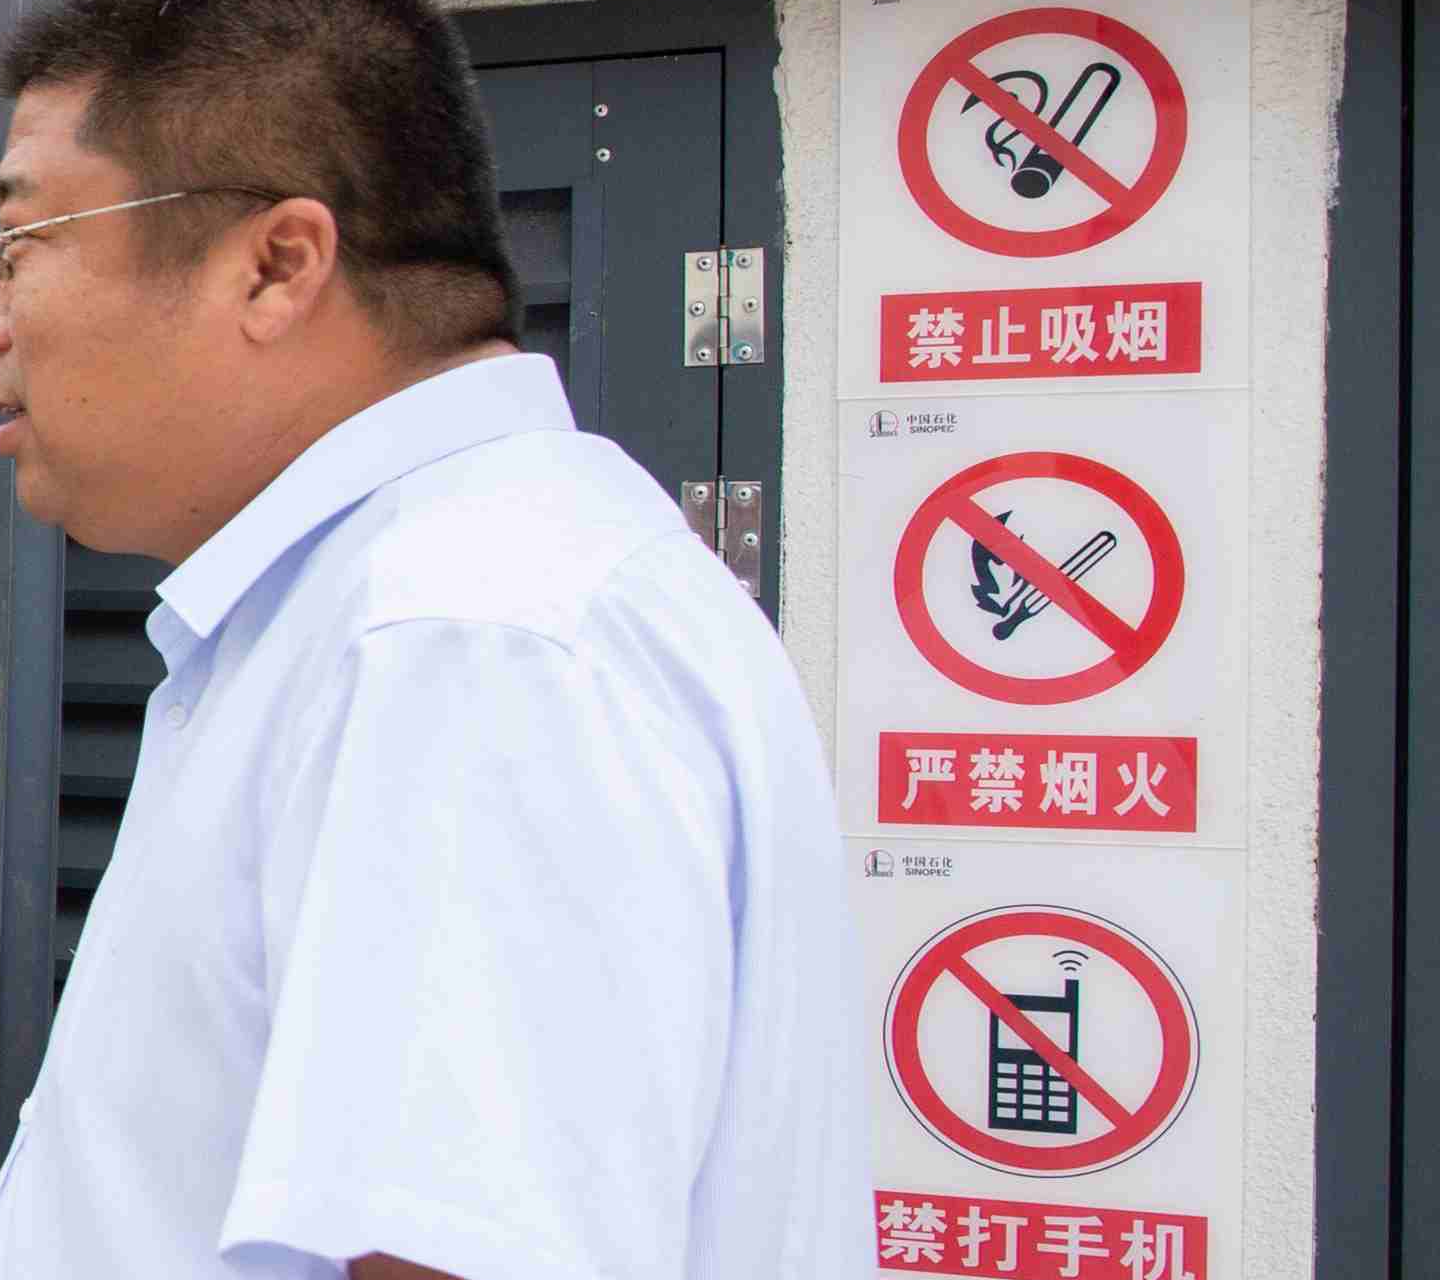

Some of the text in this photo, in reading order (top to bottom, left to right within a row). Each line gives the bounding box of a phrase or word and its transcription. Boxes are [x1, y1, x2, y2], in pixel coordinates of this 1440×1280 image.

[906, 299, 1170, 370] 禁止吸烟
[906, 412, 958, 424] 中国石化
[909, 424, 955, 434] SINOPEC
[901, 746, 1172, 819] 严禁烟火
[901, 855, 953, 868] 中国石化
[905, 867, 952, 877] SINOPEC
